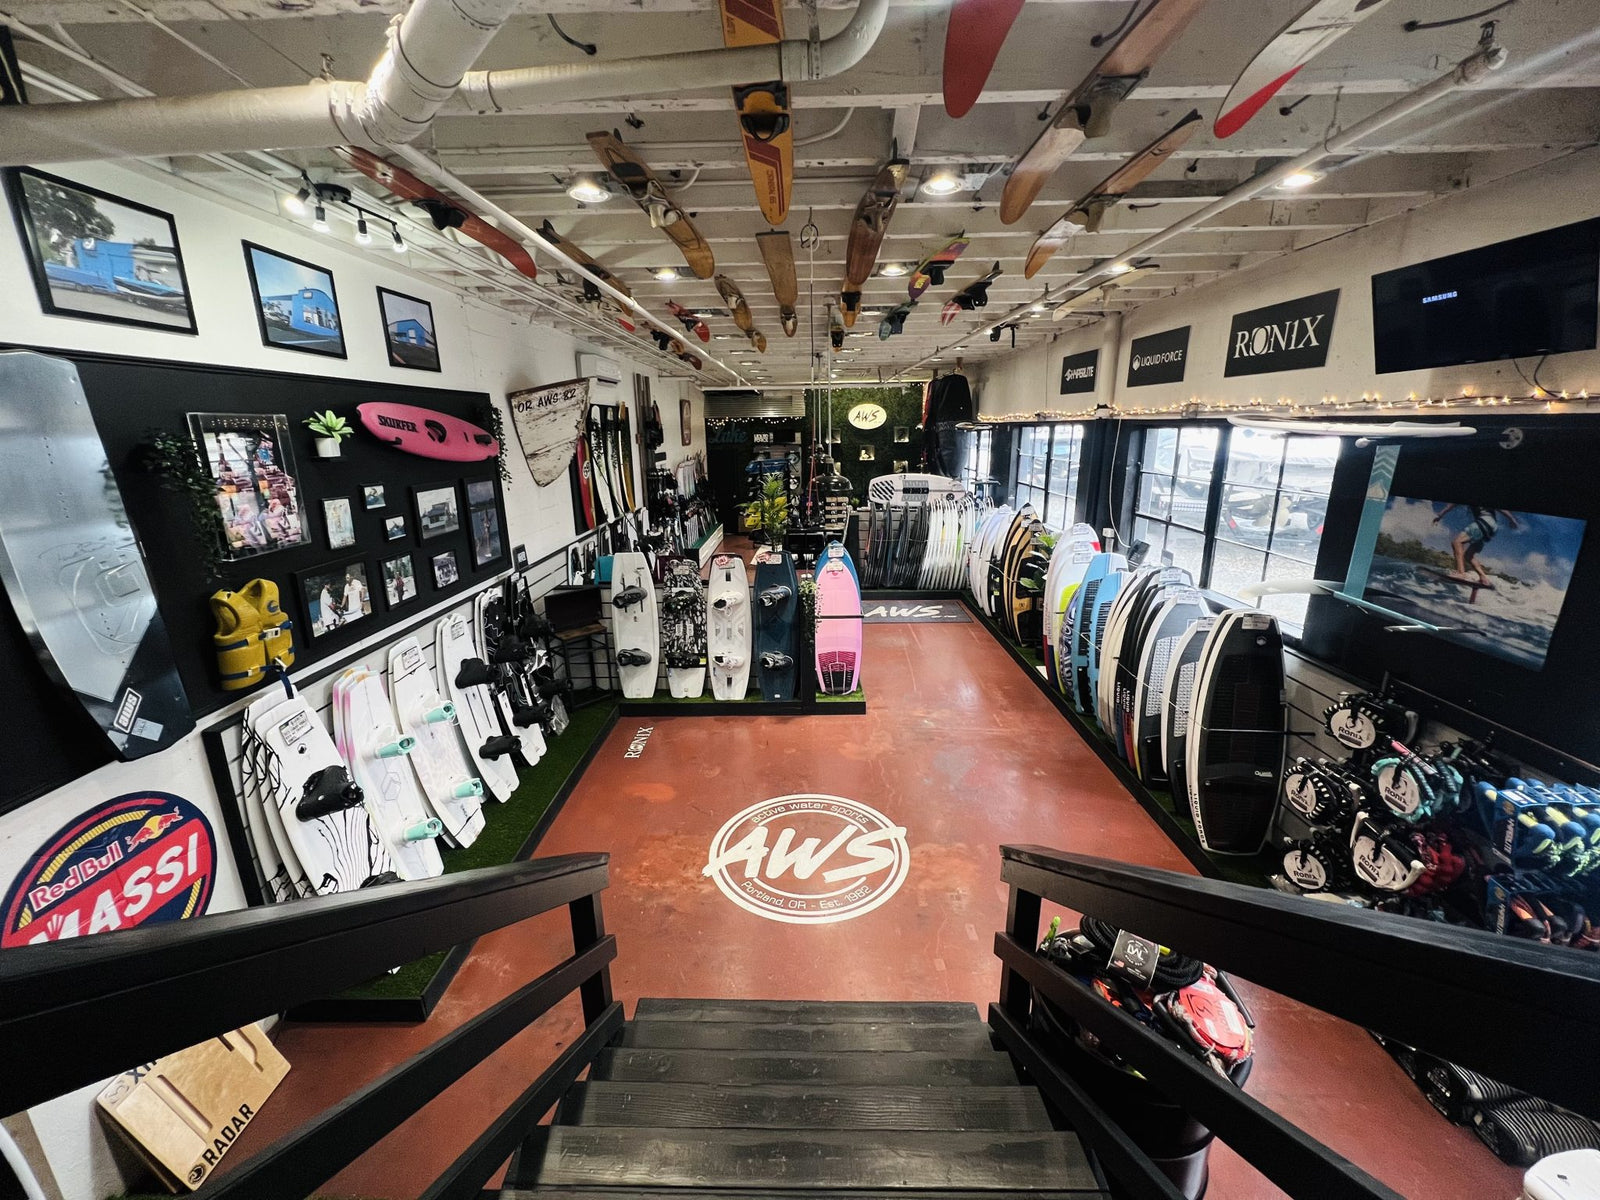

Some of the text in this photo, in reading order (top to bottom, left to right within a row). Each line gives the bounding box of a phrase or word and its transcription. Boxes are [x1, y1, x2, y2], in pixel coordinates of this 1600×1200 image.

[1422, 290, 1458, 304] SAMSUNG
[1233, 314, 1325, 359] RONIX
[1140, 350, 1183, 367] LIQUID FORCE
[517, 400, 532, 413] OR
[537, 393, 559, 407] AWS
[377, 414, 419, 433] SKURFER
[853, 409, 880, 423] AWS
[863, 605, 943, 618] AWS
[623, 726, 654, 759] RONIX
[751, 802, 870, 825] active water sports
[701, 825, 908, 884] AWS
[28, 840, 124, 912] Red Bull
[788, 899, 807, 909] OR
[819, 897, 844, 909] Est.
[844, 885, 873, 904] 1982
[202, 1103, 255, 1167] RADAR
